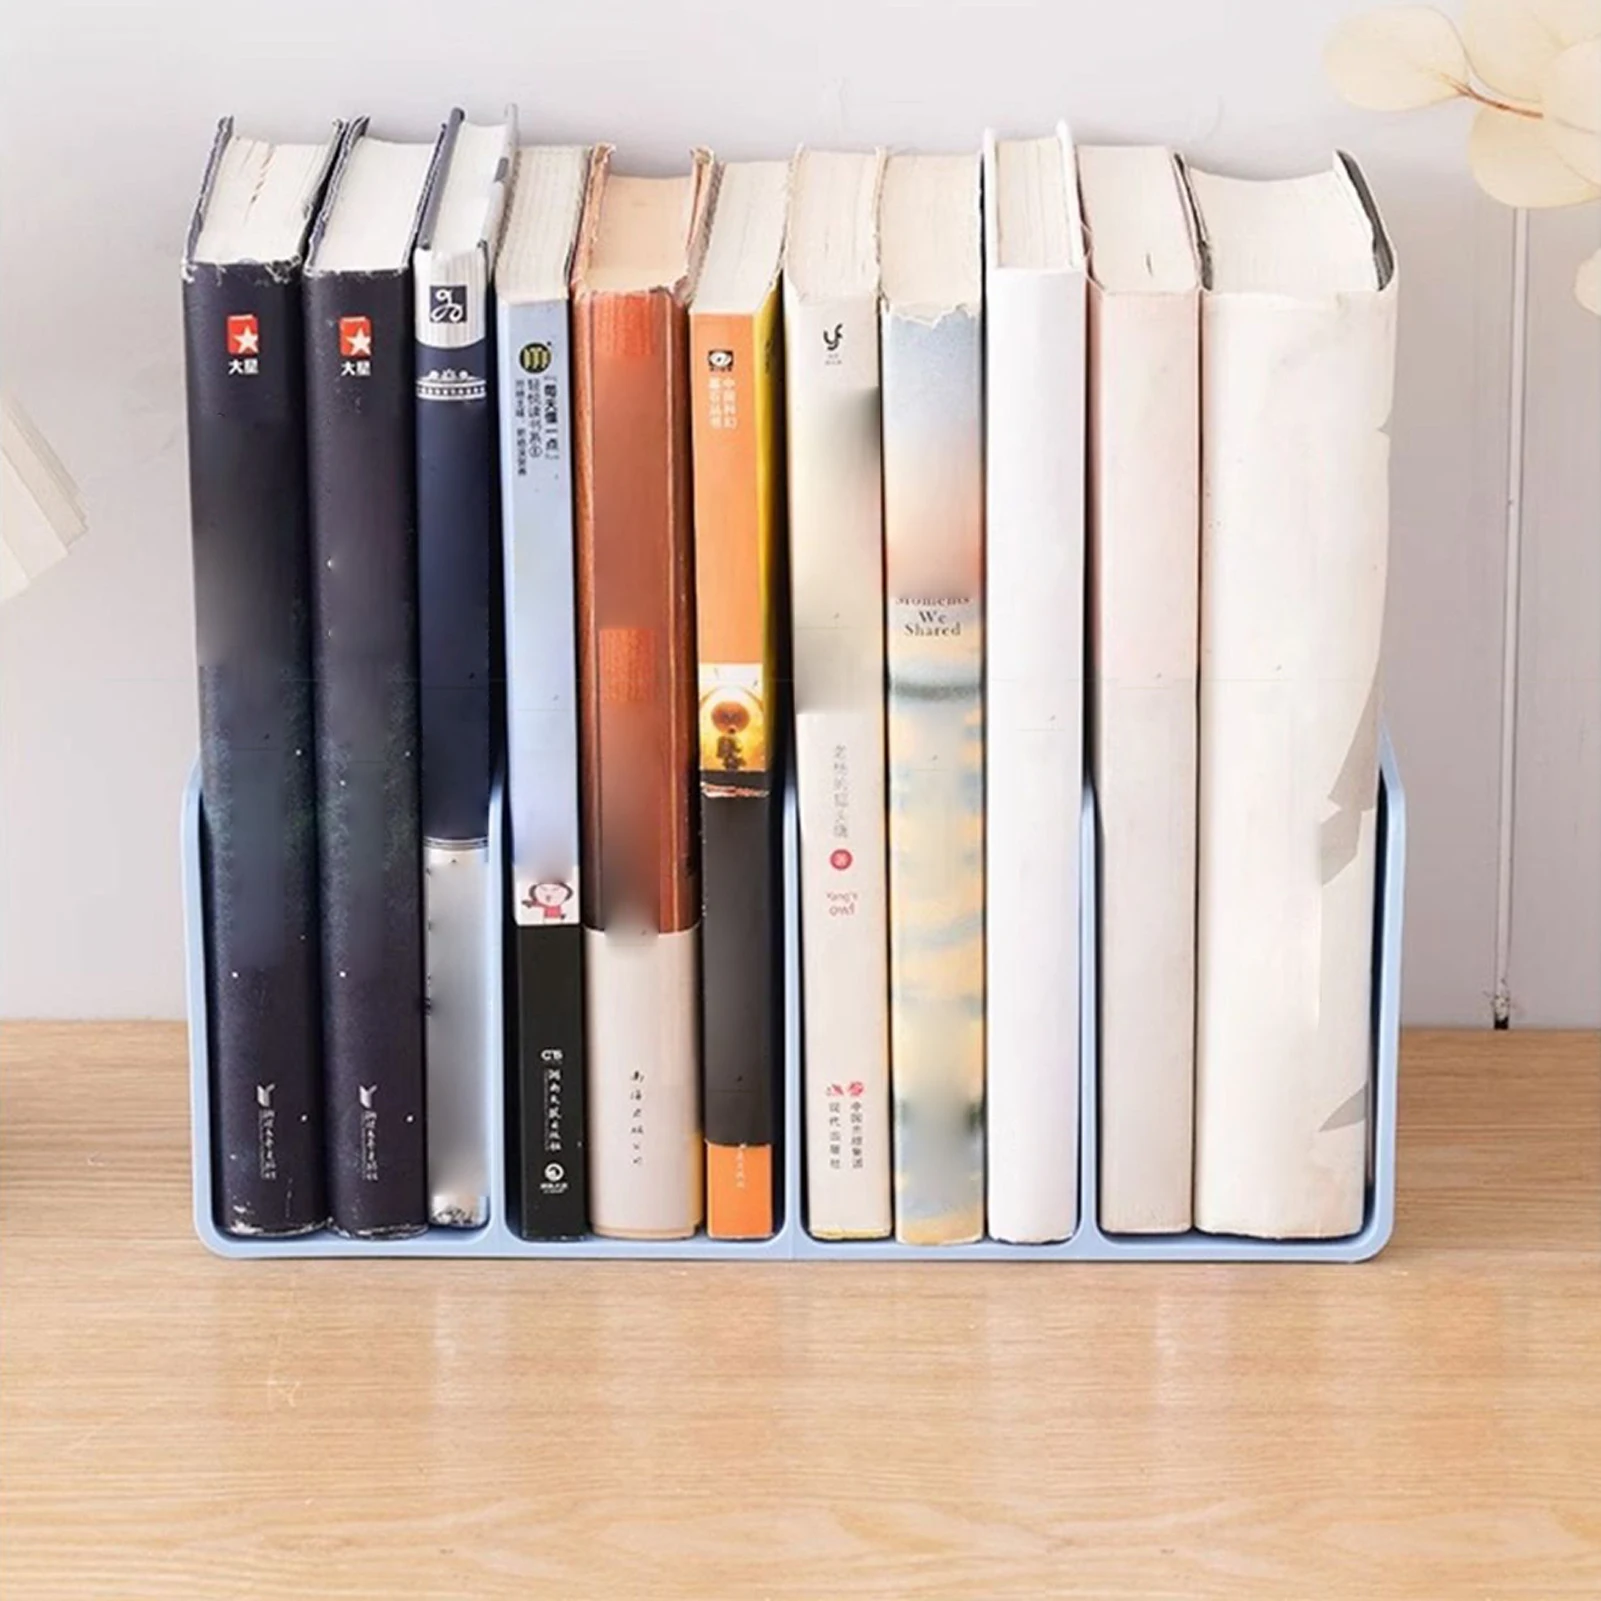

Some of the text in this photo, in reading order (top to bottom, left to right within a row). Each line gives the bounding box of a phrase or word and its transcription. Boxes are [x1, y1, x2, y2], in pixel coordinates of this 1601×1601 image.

[227, 359, 259, 375] 大星
[340, 361, 372, 376] 大星
[919, 610, 947, 624] We
[904, 621, 961, 637] Shared
